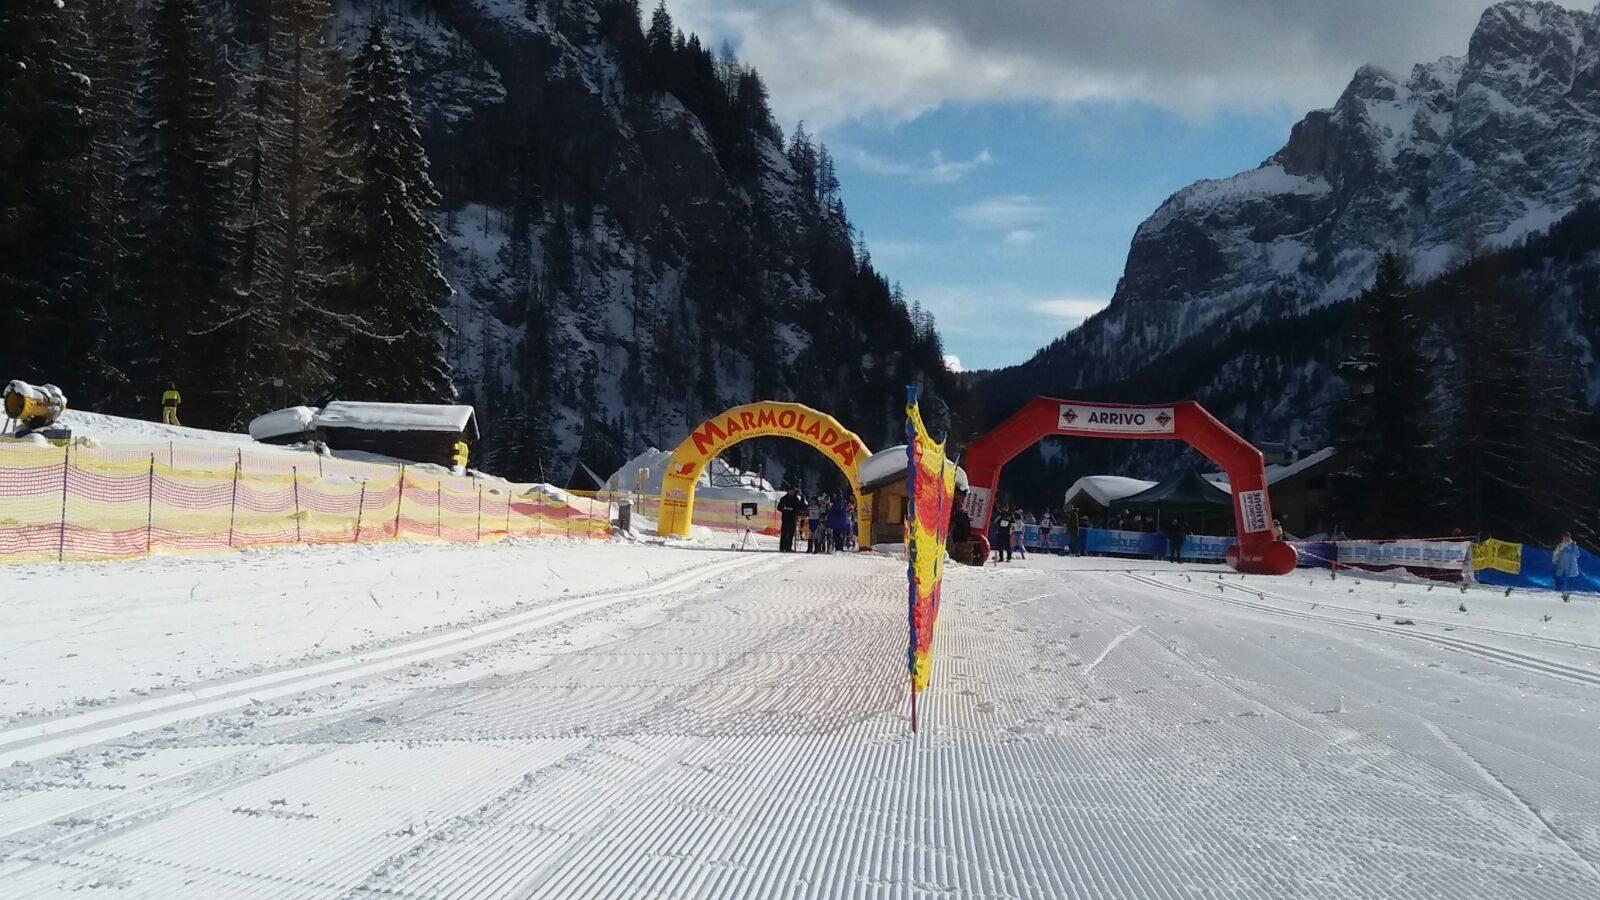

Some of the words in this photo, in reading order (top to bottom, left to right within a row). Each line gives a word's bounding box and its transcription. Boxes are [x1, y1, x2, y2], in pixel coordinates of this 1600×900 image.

[691, 408, 860, 466] MARMOLADA
[1088, 411, 1146, 426] ARRIVO
[1247, 493, 1258, 530] VOLONTARI
[1253, 492, 1266, 529] SANGUE
